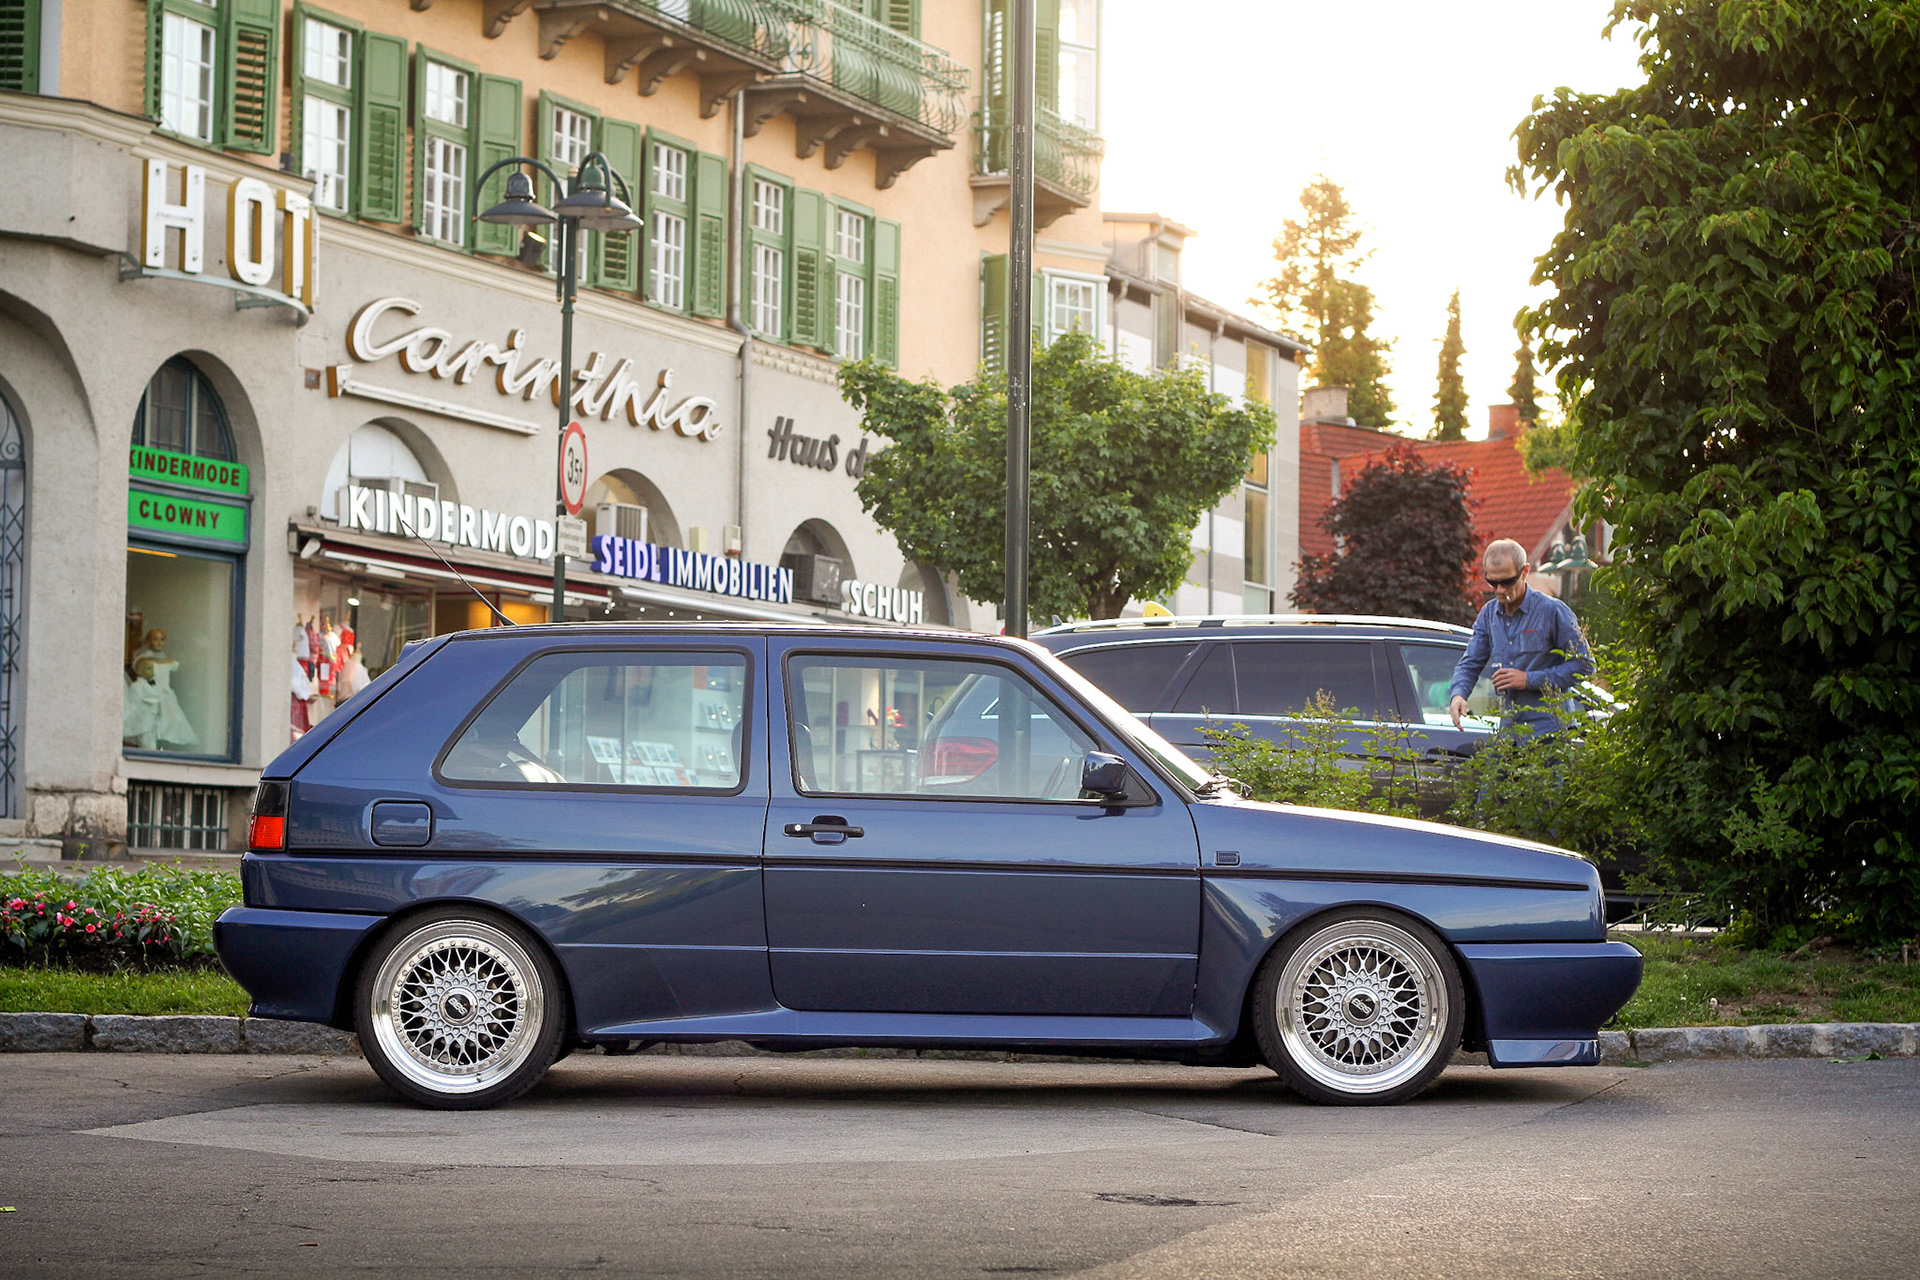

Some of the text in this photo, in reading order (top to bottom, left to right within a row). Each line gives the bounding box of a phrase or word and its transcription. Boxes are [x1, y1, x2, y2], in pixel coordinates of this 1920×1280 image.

[347, 298, 722, 442] Carinthia
[767, 416, 870, 479] Haus d
[139, 500, 220, 529] CLOWNY
[348, 485, 555, 560] KINDERMOD
[593, 534, 793, 604] SEIDL IMMOBILIEN
[844, 579, 923, 625] SCHUH
